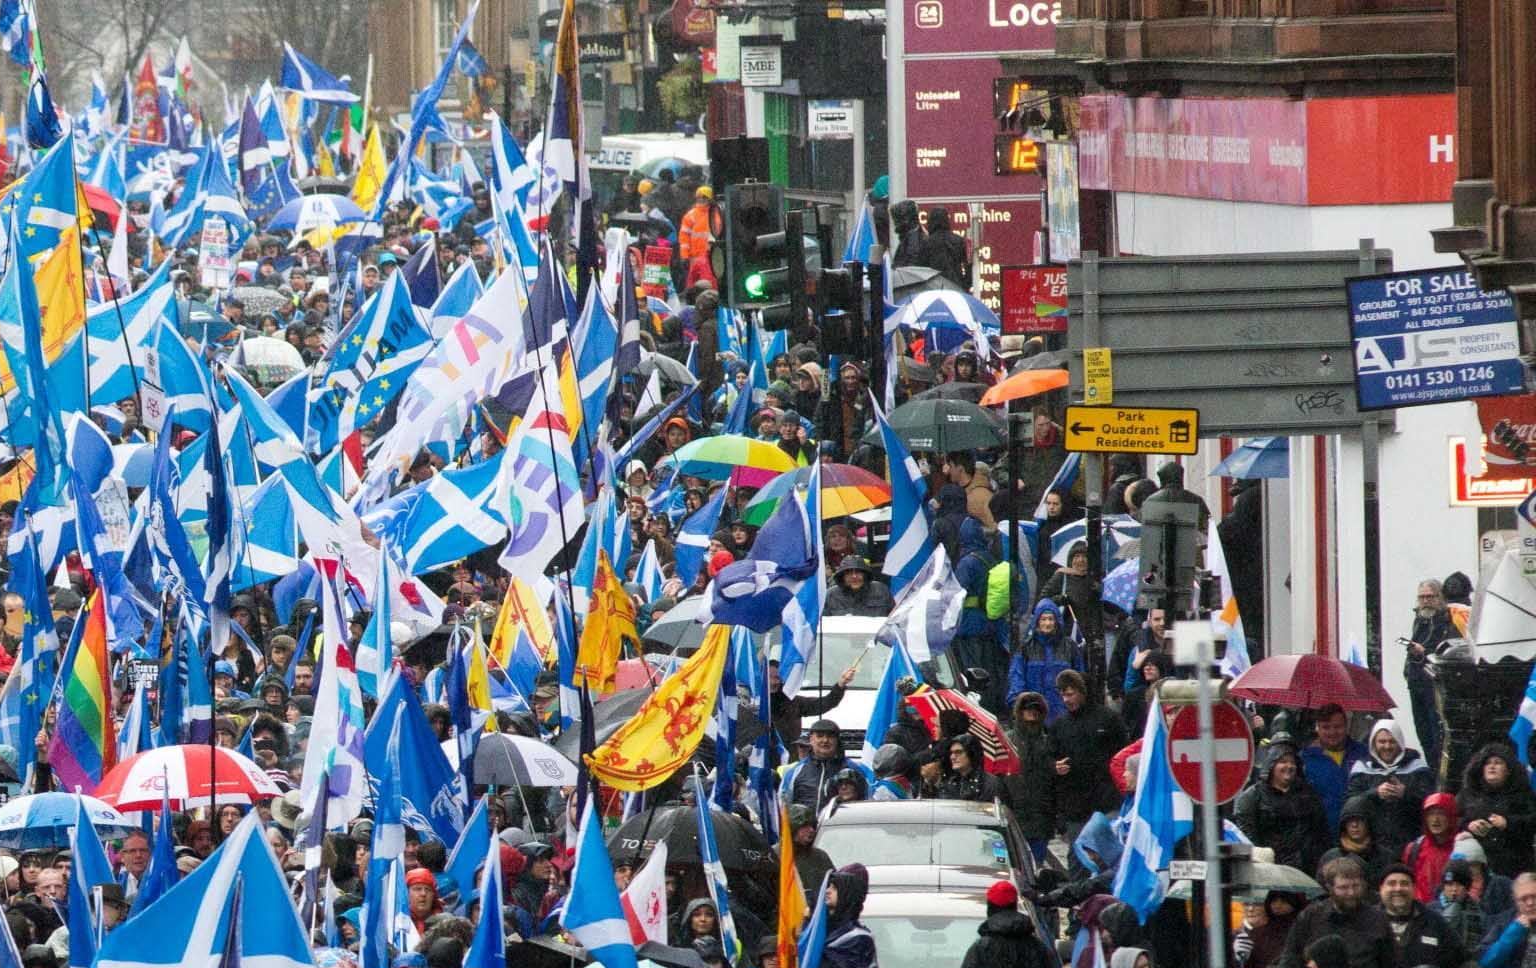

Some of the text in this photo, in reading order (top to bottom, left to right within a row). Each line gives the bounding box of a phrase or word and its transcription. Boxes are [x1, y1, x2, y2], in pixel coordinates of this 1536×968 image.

[989, 0, 1061, 27] Loca
[1043, 273, 1068, 286] JUS
[1385, 273, 1476, 297] FOR SALE
[1051, 285, 1068, 297] EA
[1360, 300, 1397, 311] GROUND
[1355, 310, 1400, 322] BASEMENT
[1406, 317, 1465, 329] ALL ENQUIRIES
[1459, 333, 1501, 344] PROPERTY
[1460, 342, 1516, 355] CONSULTANTS
[1386, 366, 1495, 389] 0141 530 1246
[1391, 384, 1492, 401] www.ajsproperty.co.uk
[1117, 411, 1145, 421] Park
[1102, 424, 1160, 435] Quadrant
[1096, 437, 1165, 448] Residences
